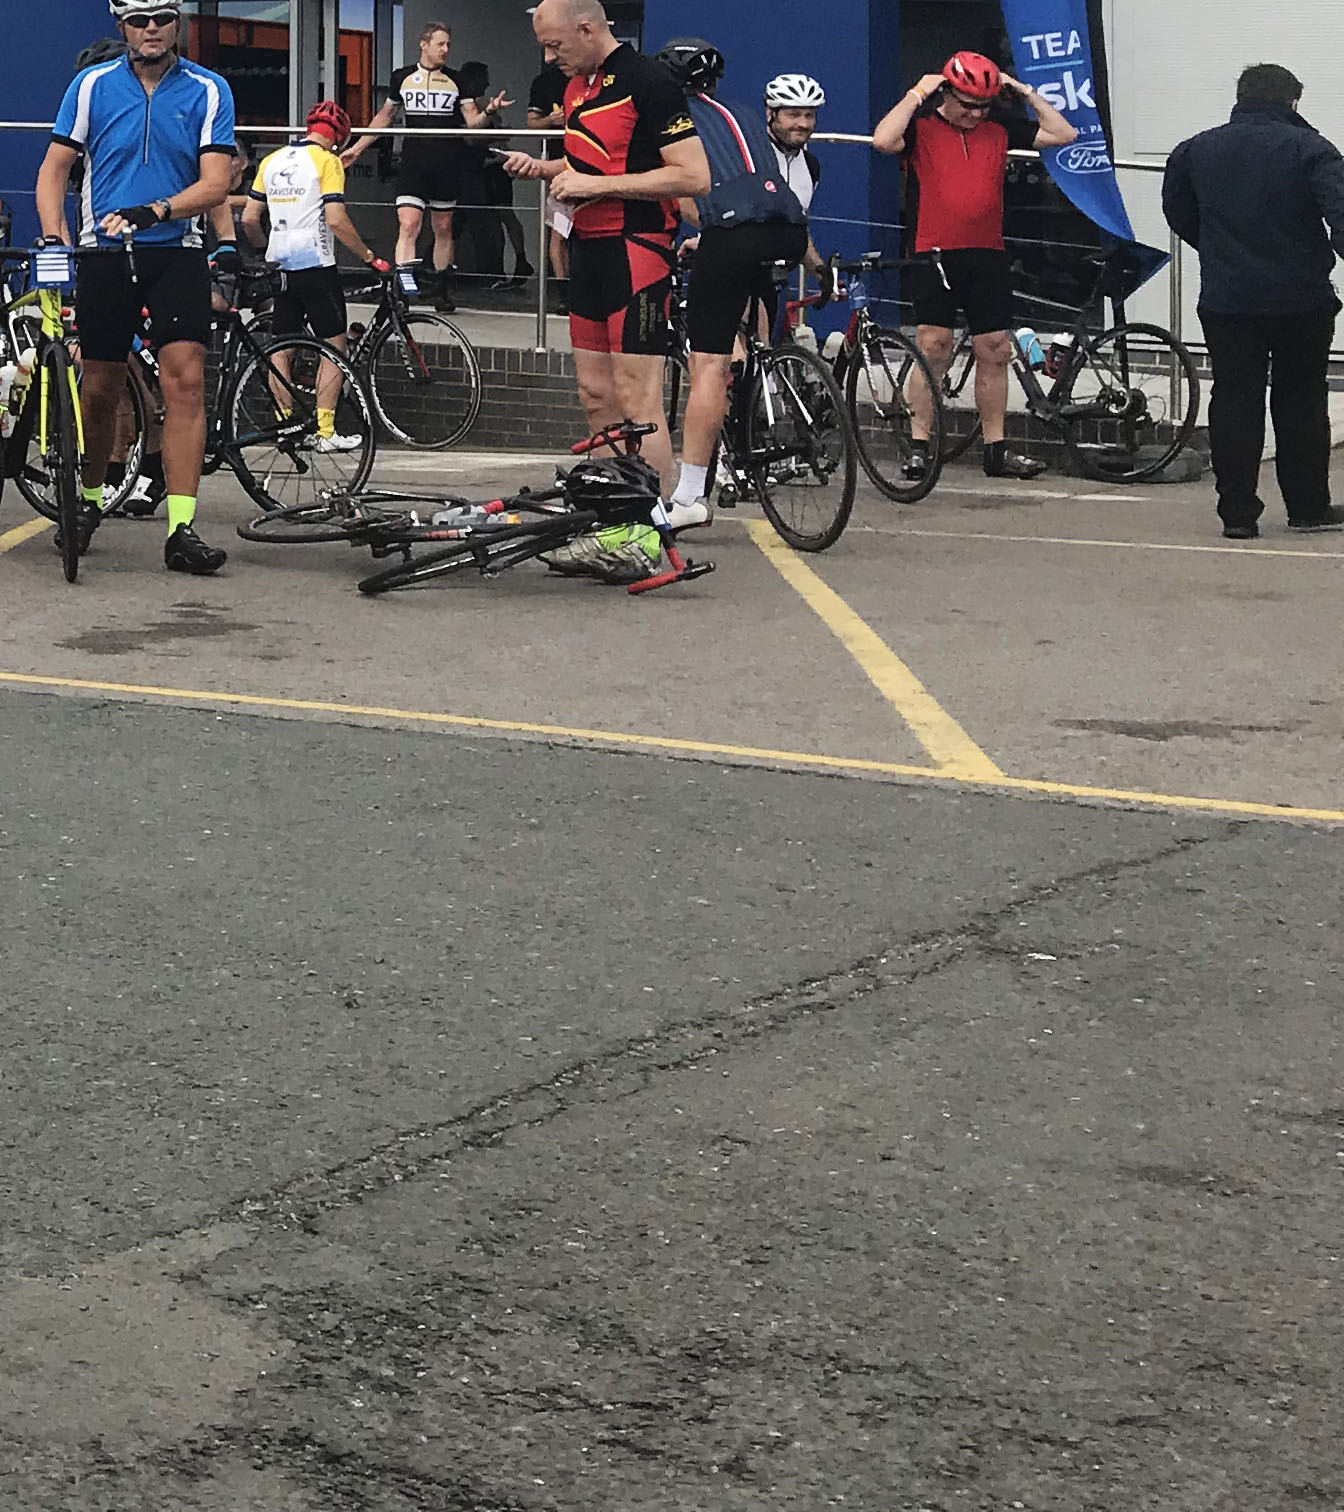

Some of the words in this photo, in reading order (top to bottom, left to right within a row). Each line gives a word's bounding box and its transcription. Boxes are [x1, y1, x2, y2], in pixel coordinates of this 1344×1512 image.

[1021, 30, 1081, 59] TEA
[405, 92, 452, 109] PRTZ
[1067, 144, 1111, 169] For
